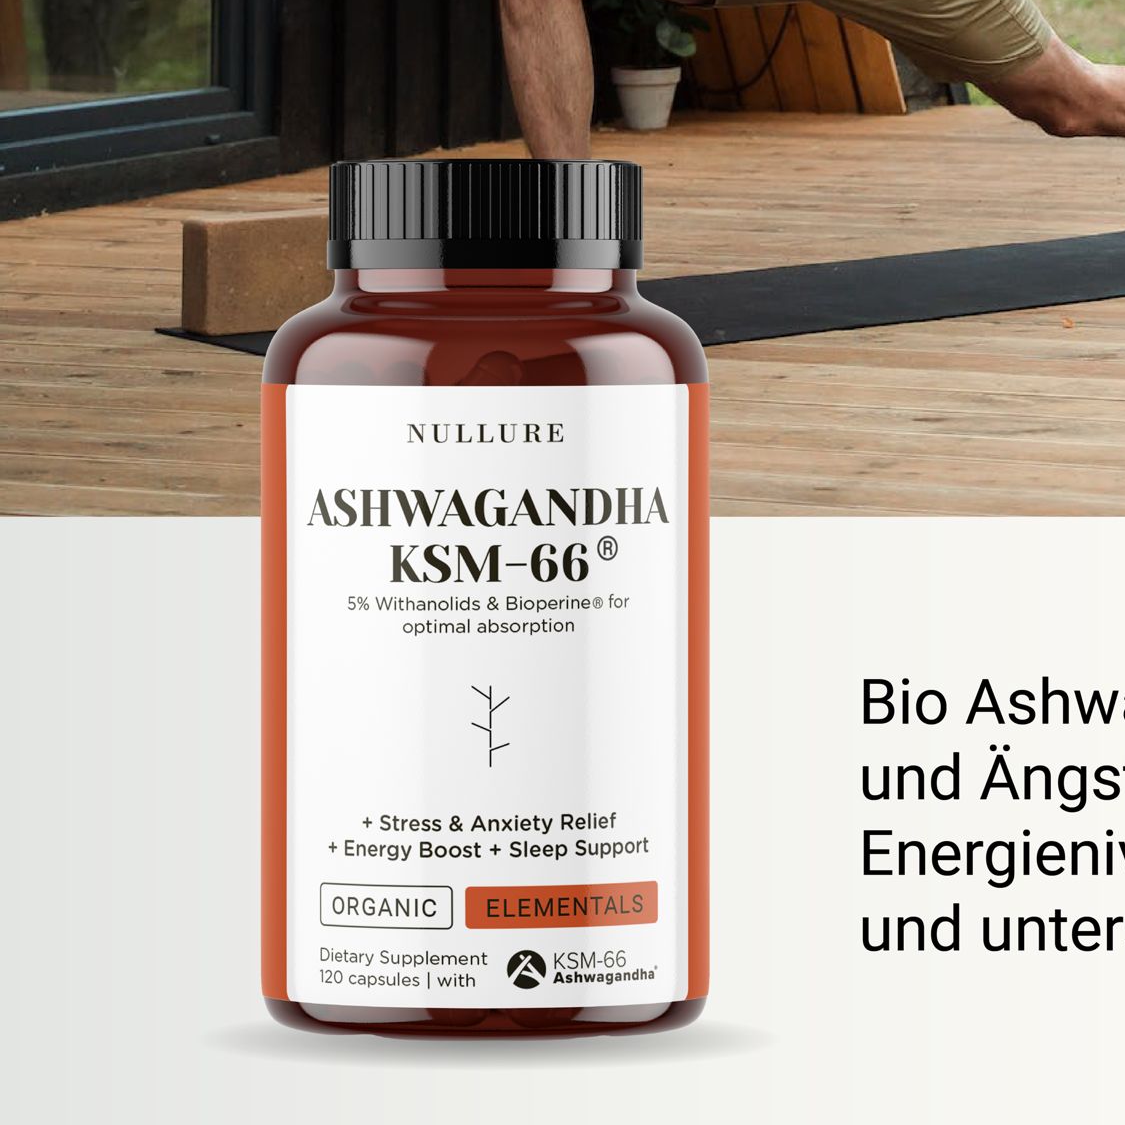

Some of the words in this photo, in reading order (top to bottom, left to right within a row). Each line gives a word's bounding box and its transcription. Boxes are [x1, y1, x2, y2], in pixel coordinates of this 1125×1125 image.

[407, 422, 564, 444] NULLURE
[306, 486, 670, 528] ASHWAGANDHA
[347, 595, 370, 611] 5%
[376, 595, 481, 612] Withanolids
[487, 595, 500, 612] &
[506, 594, 604, 614] Bioperine®
[608, 593, 630, 609] for
[402, 618, 471, 637] optimal
[477, 617, 575, 636] absorption
[362, 816, 373, 829] +
[379, 814, 442, 832] Stress
[448, 815, 464, 832] &
[470, 814, 554, 835] Anxiety
[560, 811, 617, 831] Relief
[328, 841, 338, 854] +
[344, 839, 413, 861] Energy
[419, 841, 482, 859] Boost
[489, 843, 502, 856] +
[509, 840, 569, 860] Sleep
[575, 836, 649, 859] Support
[332, 895, 437, 918] ORGANIC
[486, 894, 645, 918] ELEMENTALS
[320, 947, 374, 967] Dietary
[380, 949, 488, 968] Supplement
[553, 949, 627, 970] KSM-66
[320, 969, 344, 984] 120
[349, 972, 420, 989] capsules
[437, 972, 476, 988] with
